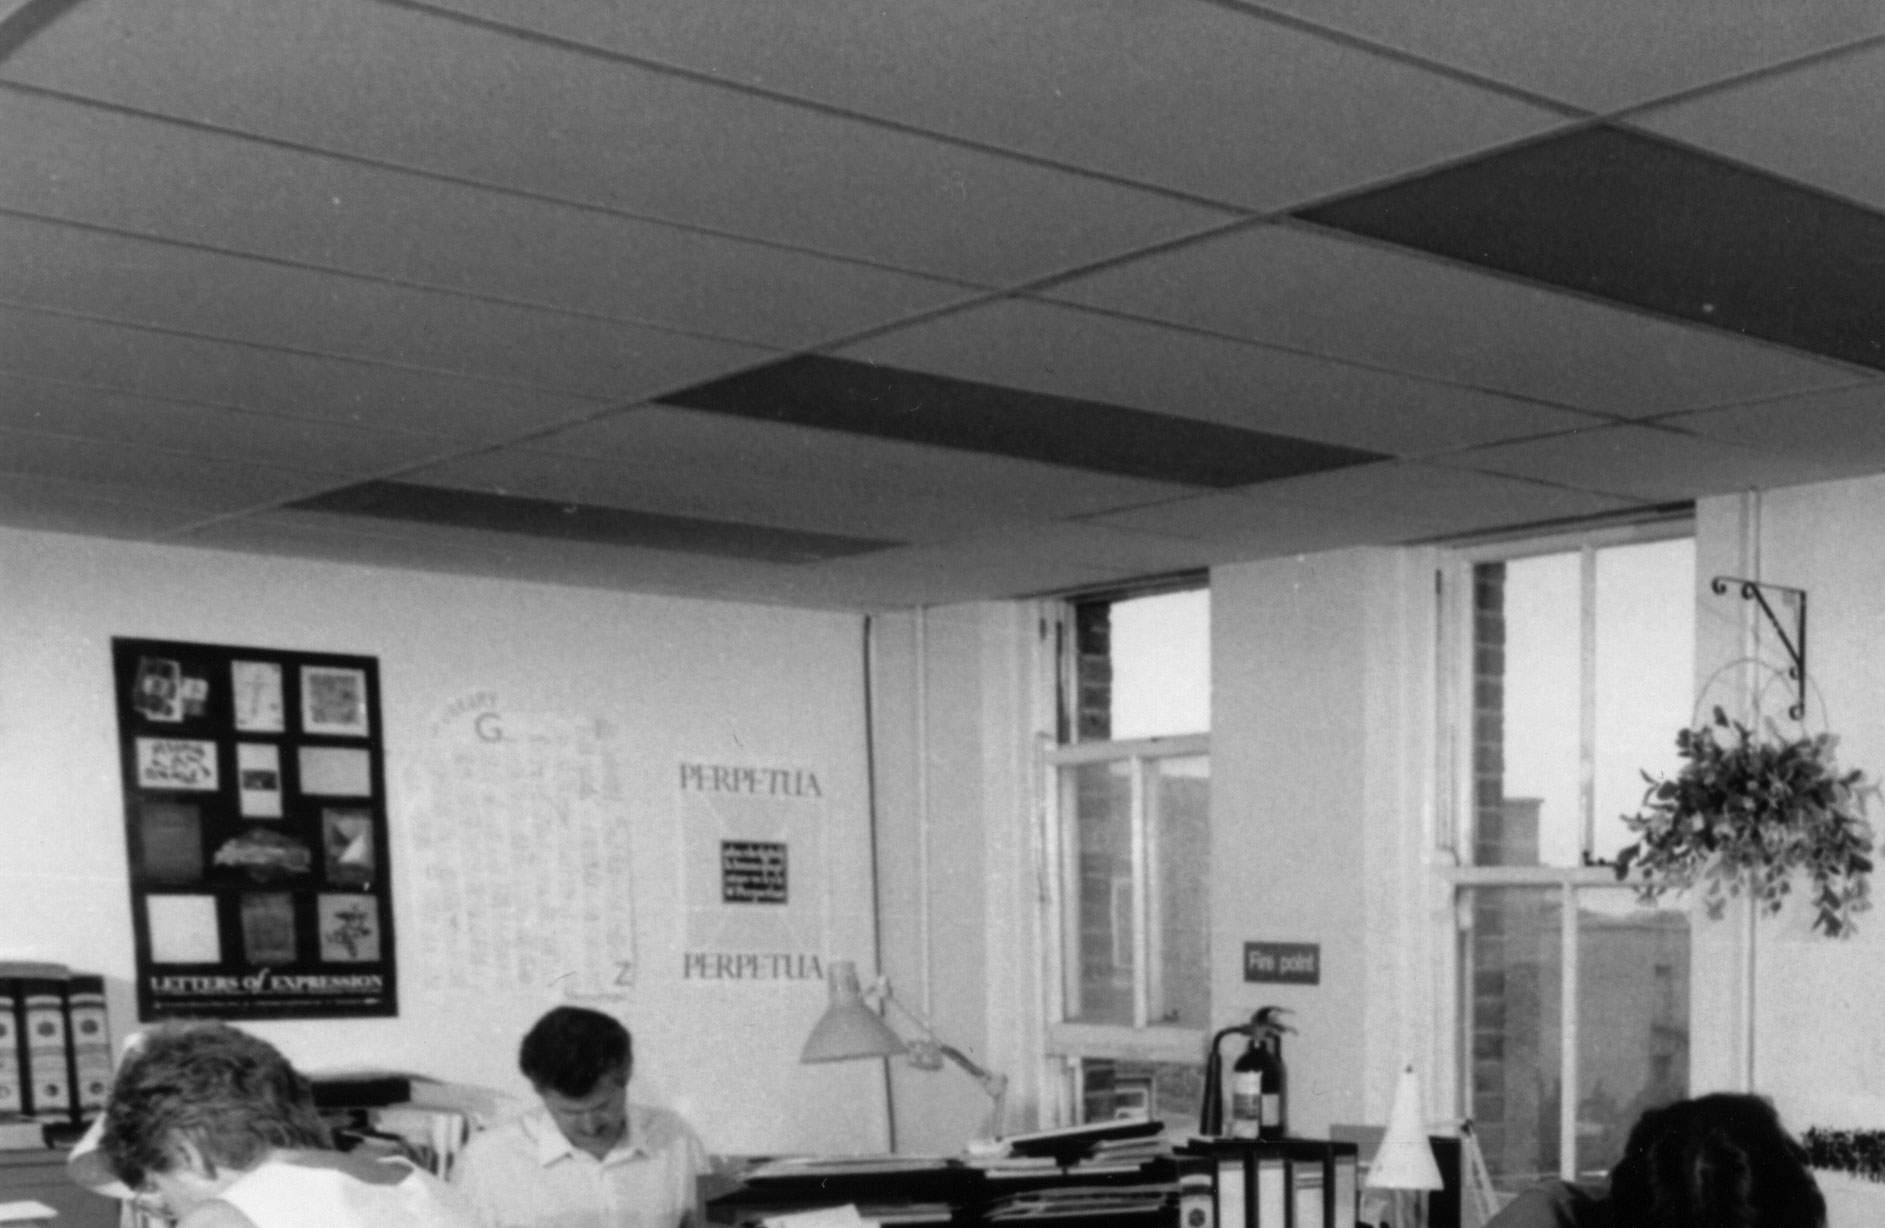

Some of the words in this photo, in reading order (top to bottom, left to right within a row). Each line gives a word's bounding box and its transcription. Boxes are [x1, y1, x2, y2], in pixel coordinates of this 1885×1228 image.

[680, 763, 823, 797] PERPETUA
[683, 951, 824, 980] PERPETUA
[1248, 950, 1275, 971] Fire
[1280, 951, 1315, 976] point
[151, 975, 239, 993] LETTERS
[271, 974, 384, 993] EXPRESSION
